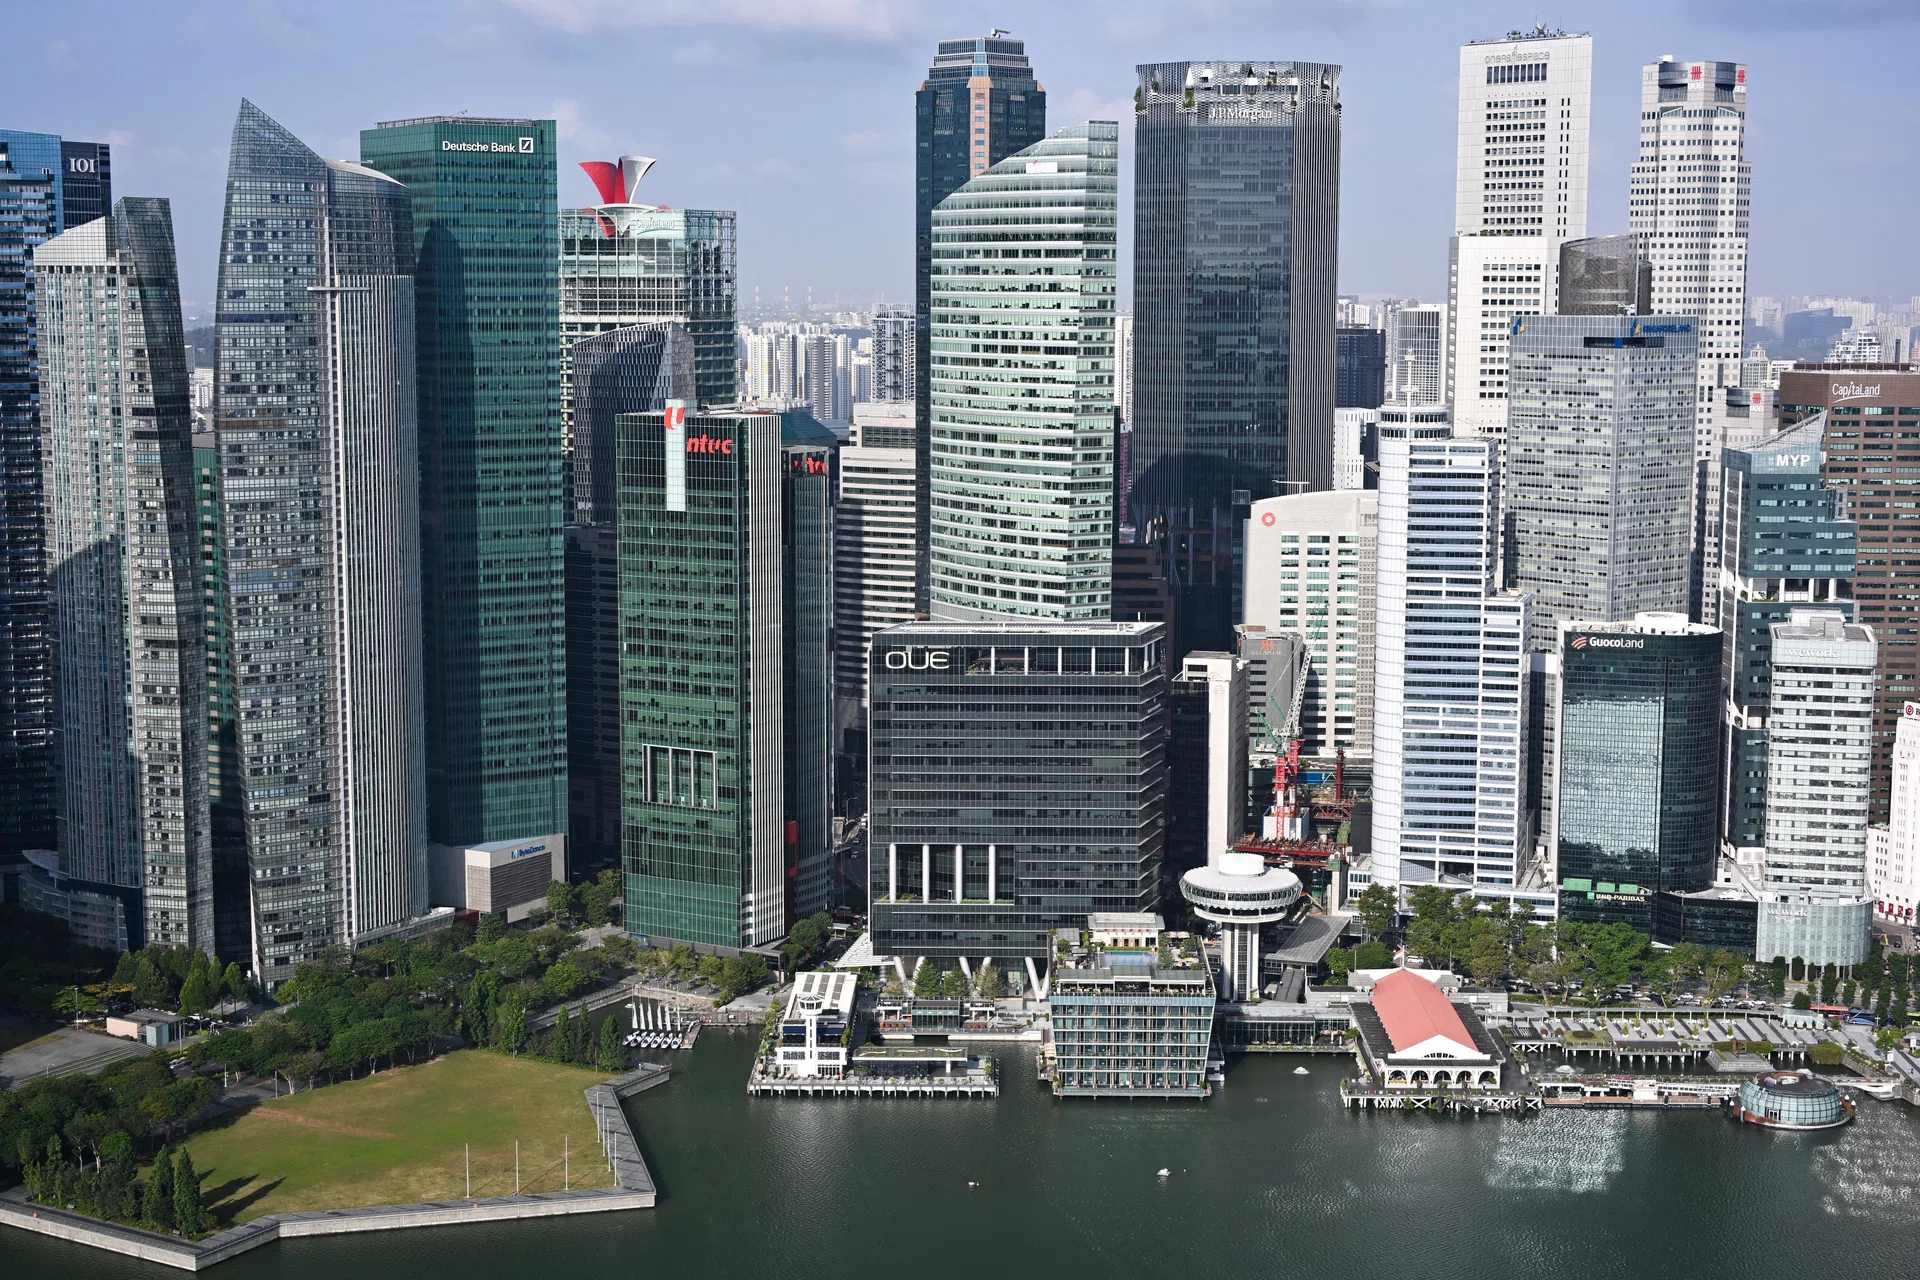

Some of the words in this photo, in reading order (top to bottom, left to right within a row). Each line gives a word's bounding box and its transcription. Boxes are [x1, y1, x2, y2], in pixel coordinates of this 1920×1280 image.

[1688, 82, 1704, 90] UOB
[442, 140, 489, 152] Deutsche
[491, 142, 516, 153] Bank
[1832, 382, 1880, 397] CapitaLand
[687, 434, 732, 454] ntuc
[1776, 454, 1811, 467] MYP
[1589, 637, 1644, 649] GuocoLand
[1787, 646, 1837, 658] wework
[886, 651, 950, 669] OUE
[1767, 907, 1808, 917] wework
